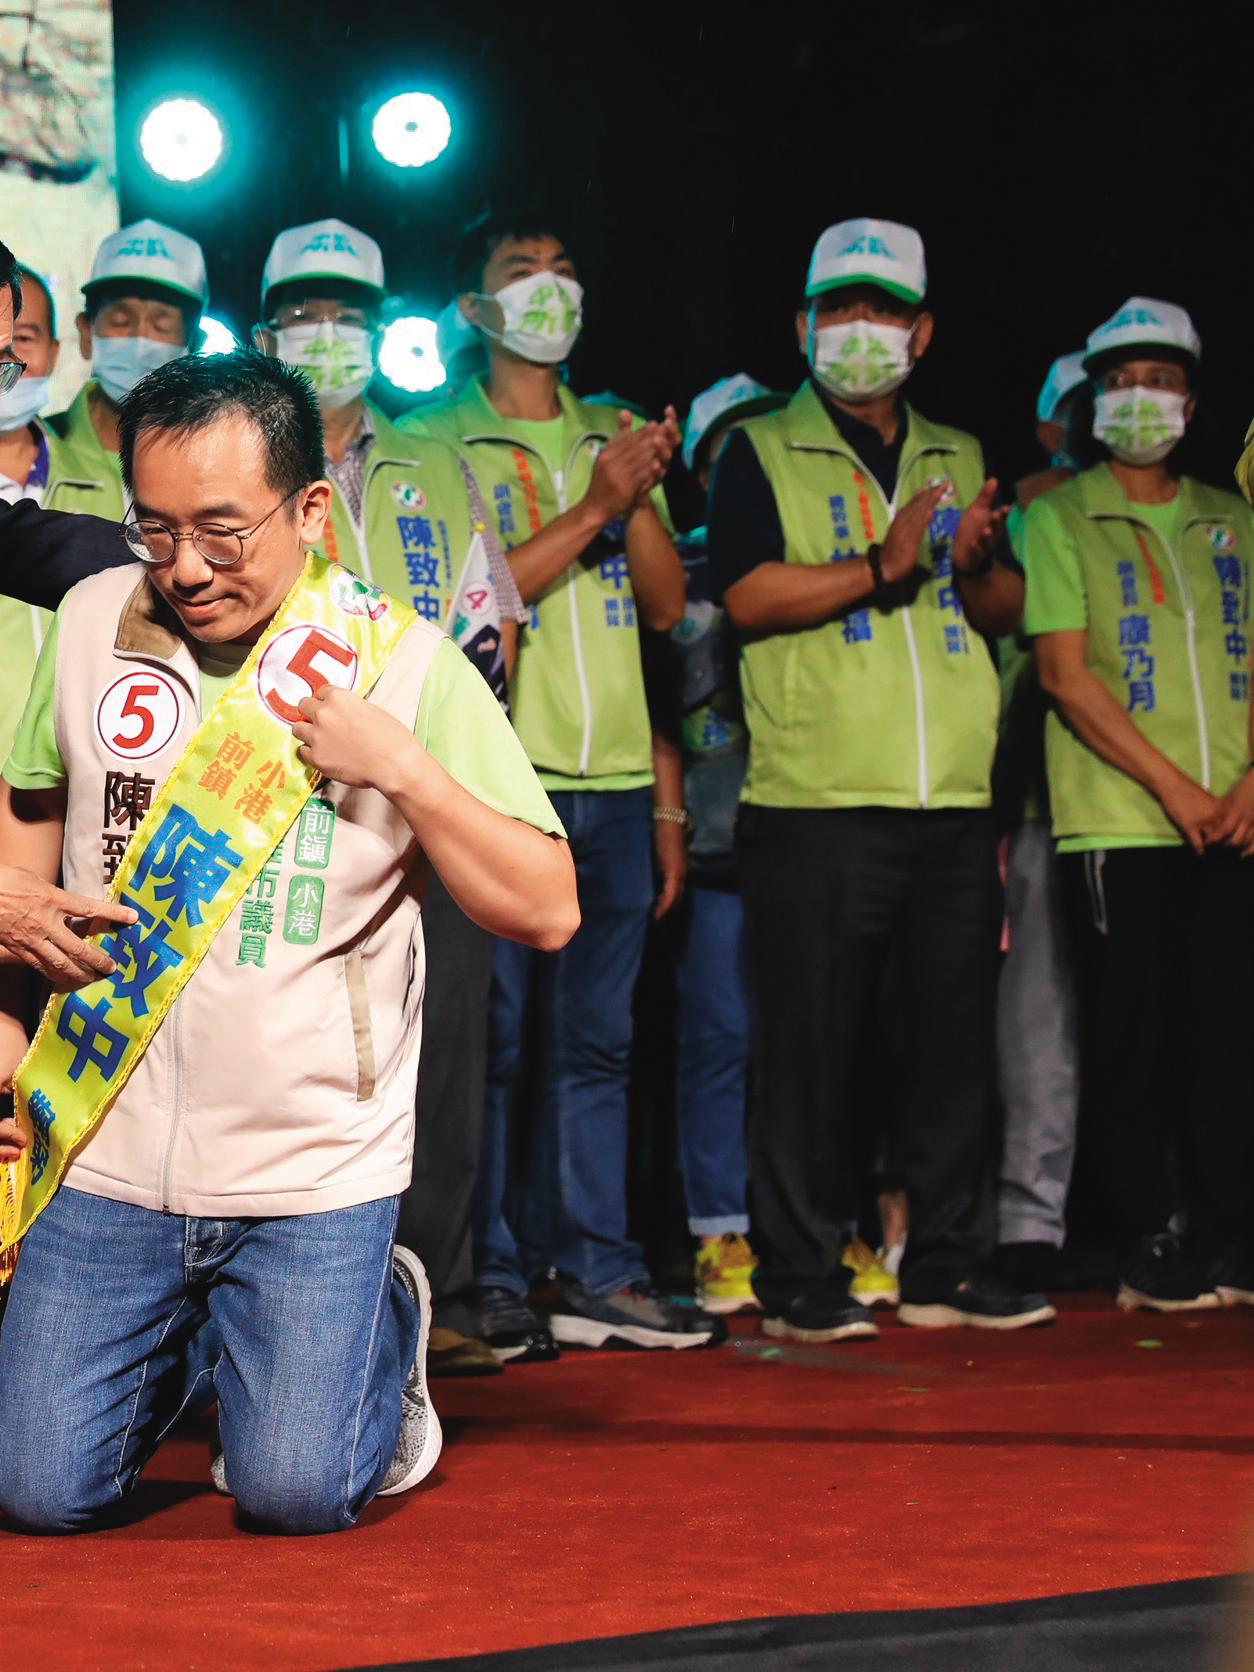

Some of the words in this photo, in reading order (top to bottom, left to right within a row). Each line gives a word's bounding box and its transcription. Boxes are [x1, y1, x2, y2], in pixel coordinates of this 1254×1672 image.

[397, 516, 440, 621] 陳致中
[265, 628, 356, 723] 5
[112, 684, 159, 750] 5
[197, 731, 256, 800] 前鎮
[233, 759, 286, 825] 小港
[297, 804, 333, 865] 前鎮
[56, 803, 244, 1083] 陳致中
[287, 883, 319, 937] 小港
